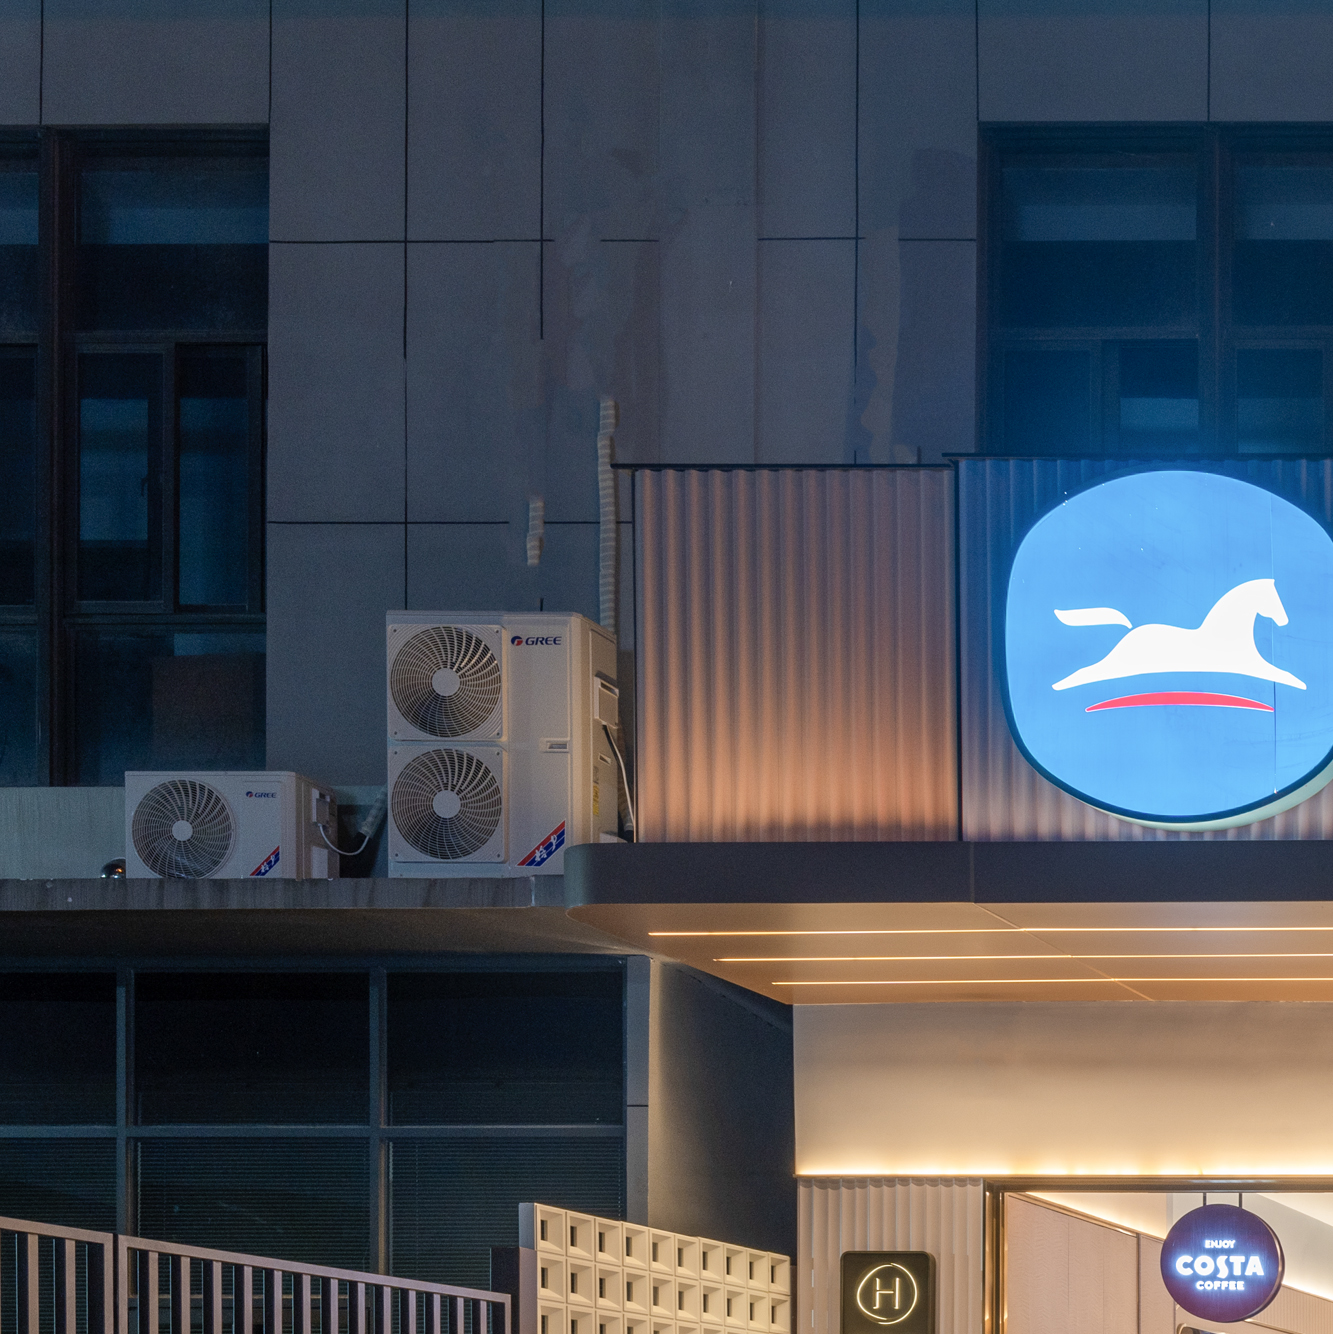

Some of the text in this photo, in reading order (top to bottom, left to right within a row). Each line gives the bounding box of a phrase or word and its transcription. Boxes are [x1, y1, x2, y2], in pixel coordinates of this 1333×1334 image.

[525, 636, 562, 646] GREE
[1204, 1239, 1236, 1249] ENJOY
[1175, 1255, 1265, 1279] COSTA
[1195, 1281, 1245, 1291] COFFEE
